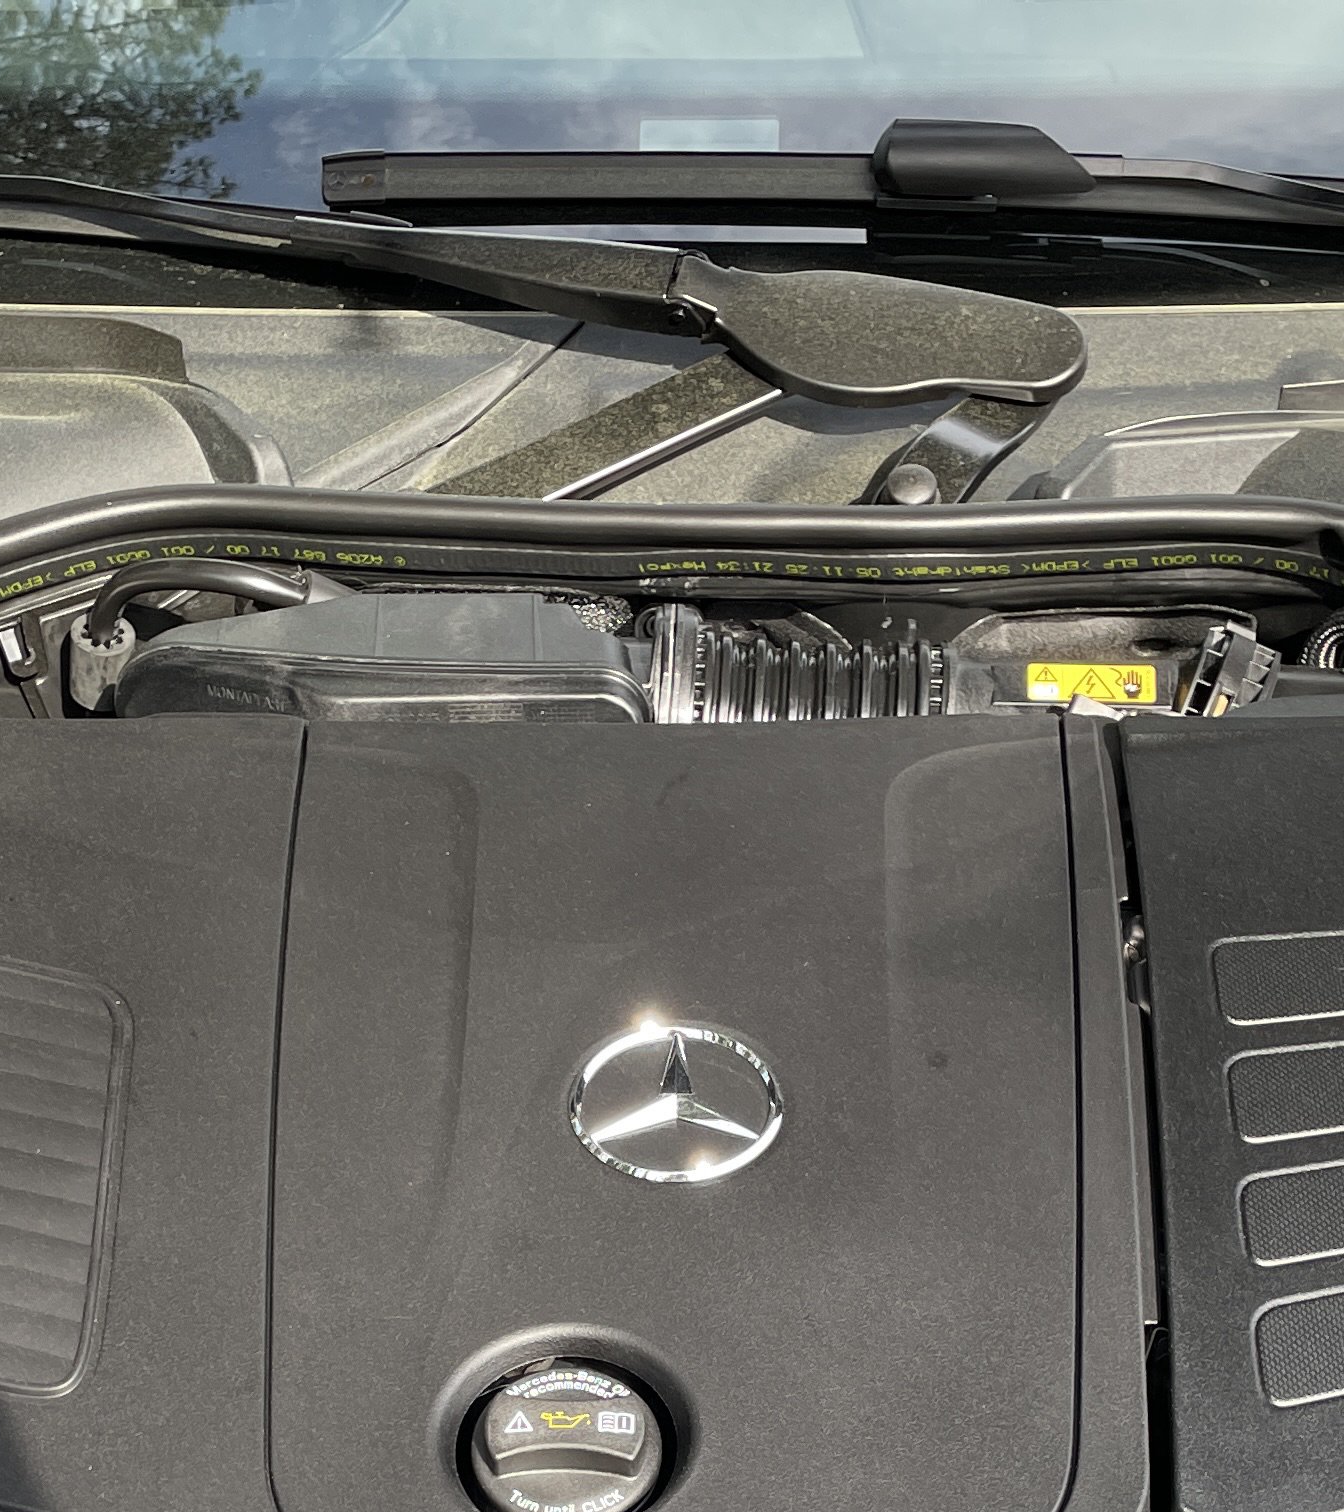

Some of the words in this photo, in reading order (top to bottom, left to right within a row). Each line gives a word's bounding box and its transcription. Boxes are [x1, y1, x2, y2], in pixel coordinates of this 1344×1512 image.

[63, 559, 97, 577] ELP
[638, 560, 707, 572] Hexpol
[716, 559, 773, 572] 21:34
[1103, 557, 1139, 569] ELP
[891, 564, 1012, 577] Stahldraht
[506, 1371, 612, 1396] Mercedes-Benz
